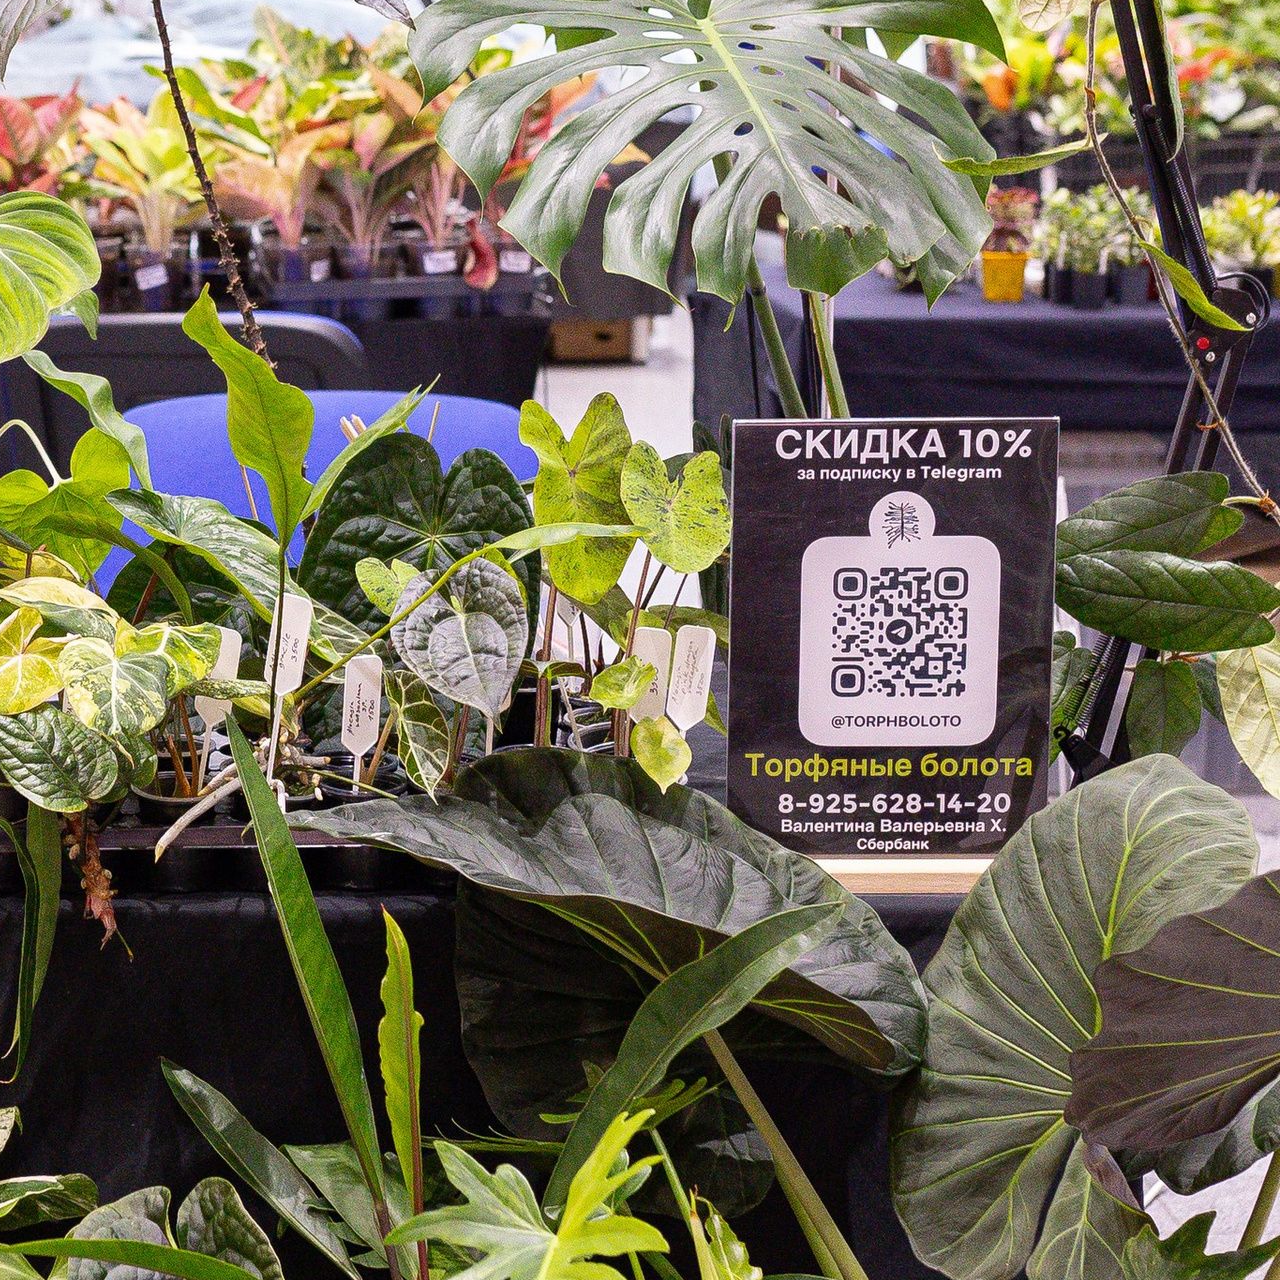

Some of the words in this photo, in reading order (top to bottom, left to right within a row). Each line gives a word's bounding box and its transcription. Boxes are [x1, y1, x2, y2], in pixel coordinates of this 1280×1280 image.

[775, 428, 946, 464] СКИДКА
[958, 428, 1032, 459] 10%
[797, 468, 815, 480] за
[819, 468, 902, 483] подписку
[906, 468, 916, 479] в
[920, 465, 1002, 481] Telegram
[830, 714, 962, 729] @TORPHBOLOTO
[745, 753, 911, 782] Торфяные
[920, 752, 1033, 777] болота
[778, 792, 1012, 815] 8-925-628-14-20
[781, 819, 875, 833] Валентина
[880, 819, 985, 835] Валерьевна
[856, 836, 930, 852] Сбербанк
